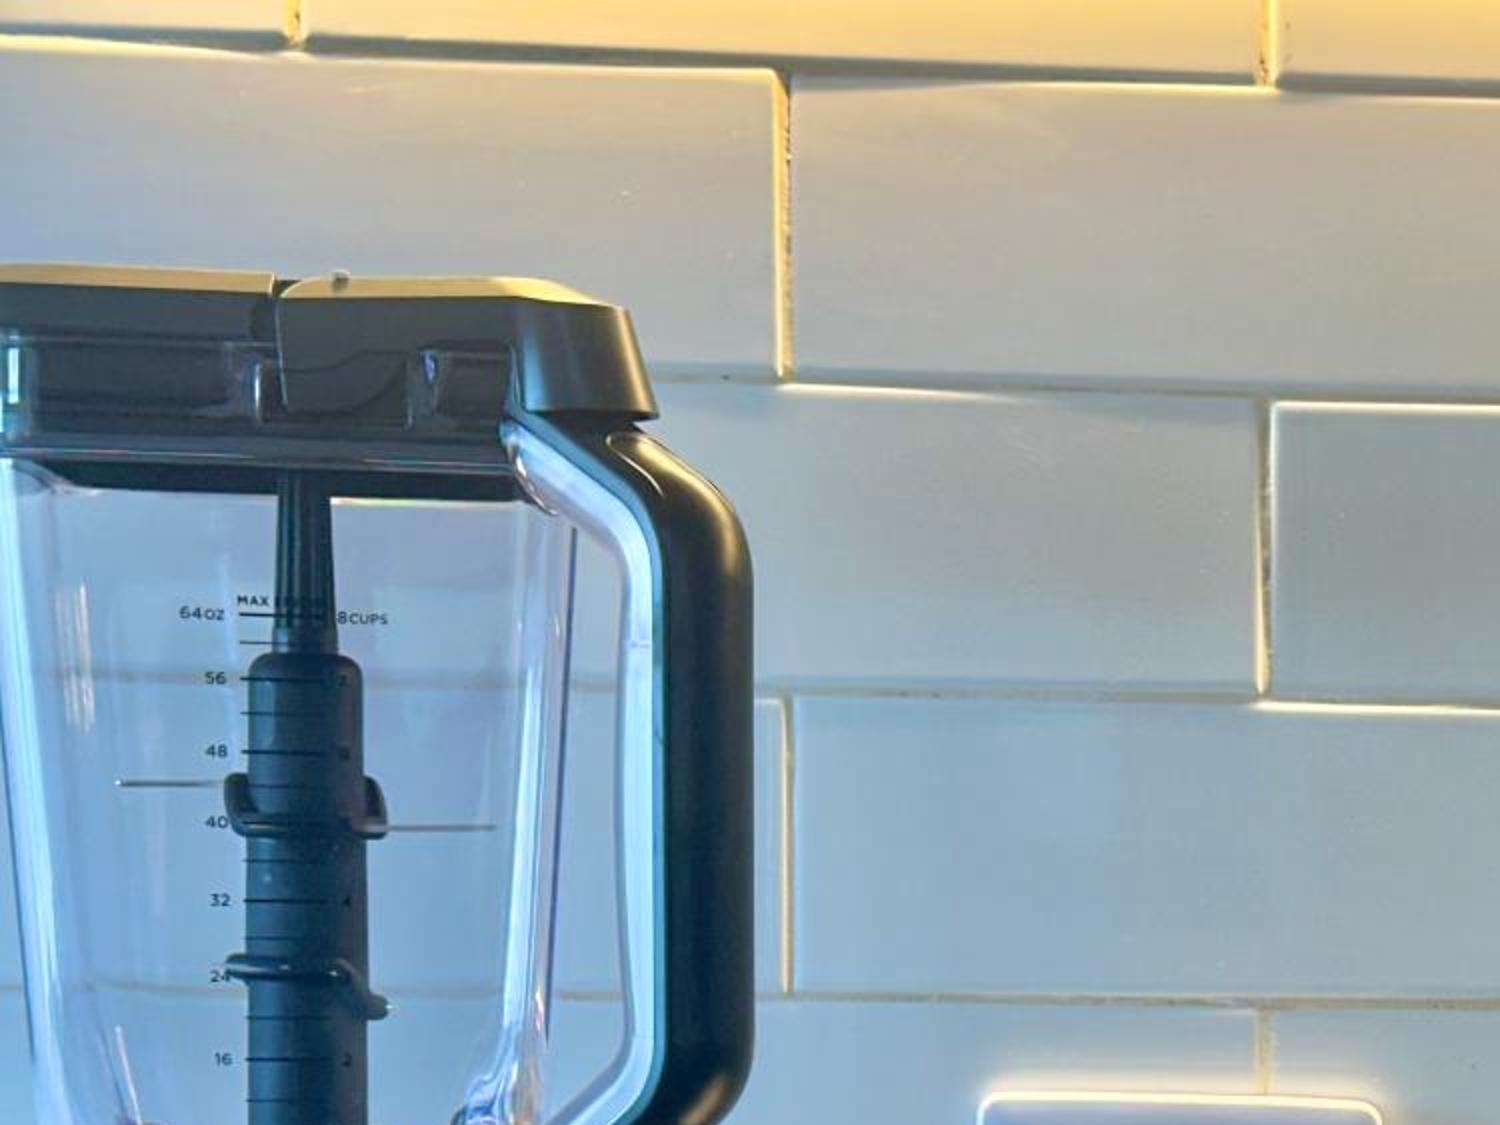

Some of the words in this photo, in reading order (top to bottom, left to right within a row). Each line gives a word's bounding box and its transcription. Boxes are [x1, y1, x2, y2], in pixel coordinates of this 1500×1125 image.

[237, 595, 270, 607] MAX
[204, 671, 227, 685] 56
[204, 744, 228, 758] 48
[205, 815, 229, 829] 40
[210, 893, 231, 907] 32
[214, 1052, 233, 1066] 16
